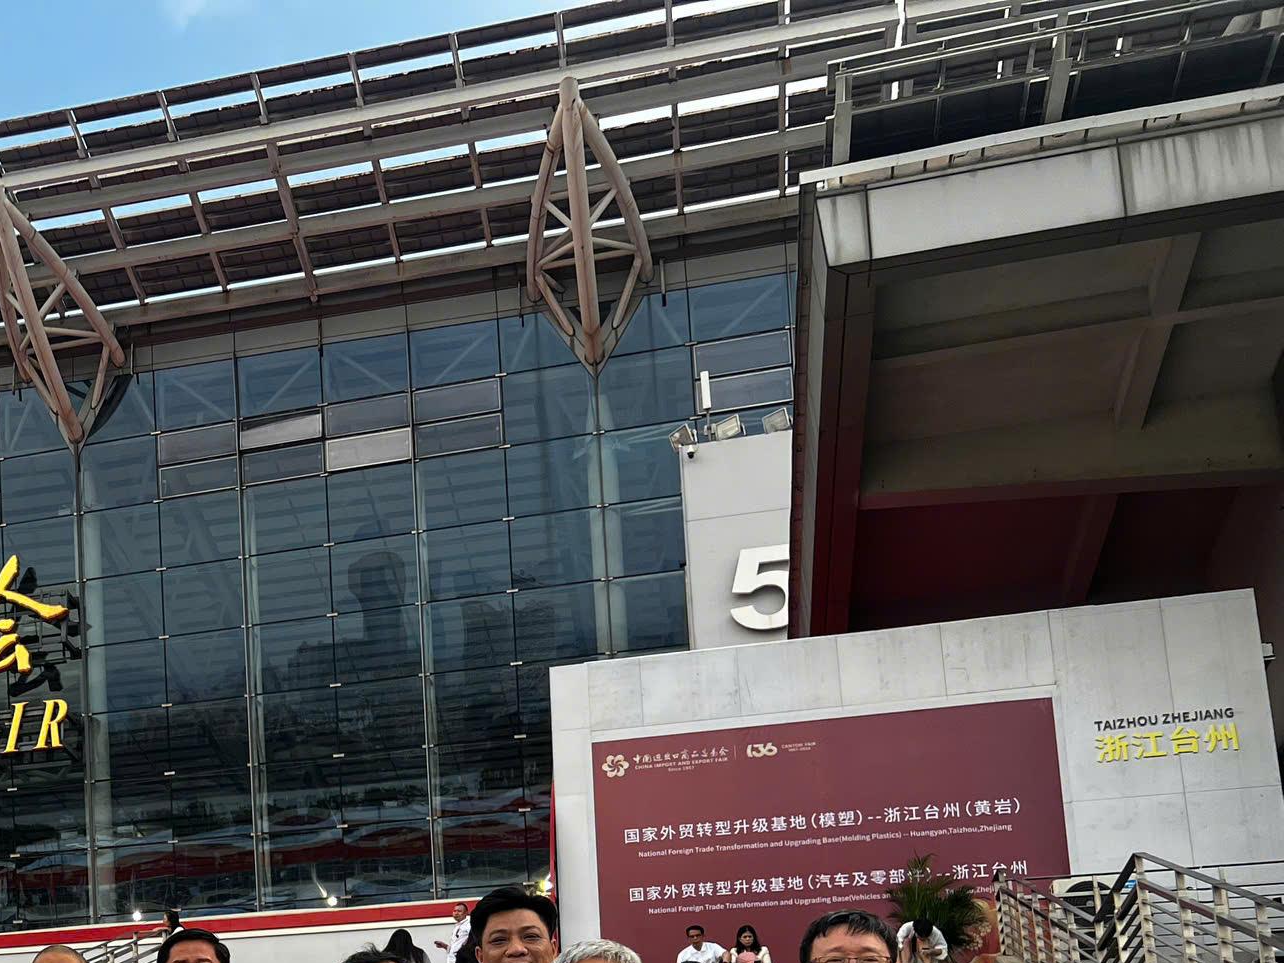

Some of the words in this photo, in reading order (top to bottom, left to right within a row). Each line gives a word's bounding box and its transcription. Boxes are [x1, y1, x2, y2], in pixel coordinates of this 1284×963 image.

[730, 543, 790, 630] 5
[1094, 715, 1158, 732] TAIZHOU
[1162, 707, 1235, 725] ZHEJIANG
[746, 742, 778, 758] 136
[1094, 722, 1240, 763] 浙江台州
[638, 849, 667, 858] National
[668, 847, 694, 856] Foreign
[695, 845, 715, 854] Trade
[716, 842, 769, 852] Transformation
[770, 840, 783, 848] and
[784, 837, 821, 848] Upgrading
[872, 831, 902, 841] Plastics)
[648, 905, 678, 915] National
[678, 904, 704, 913] Foreign
[705, 902, 725, 911] Trade
[726, 900, 779, 910] Transformation
[780, 898, 793, 906] and
[794, 896, 831, 907] Upgrading
